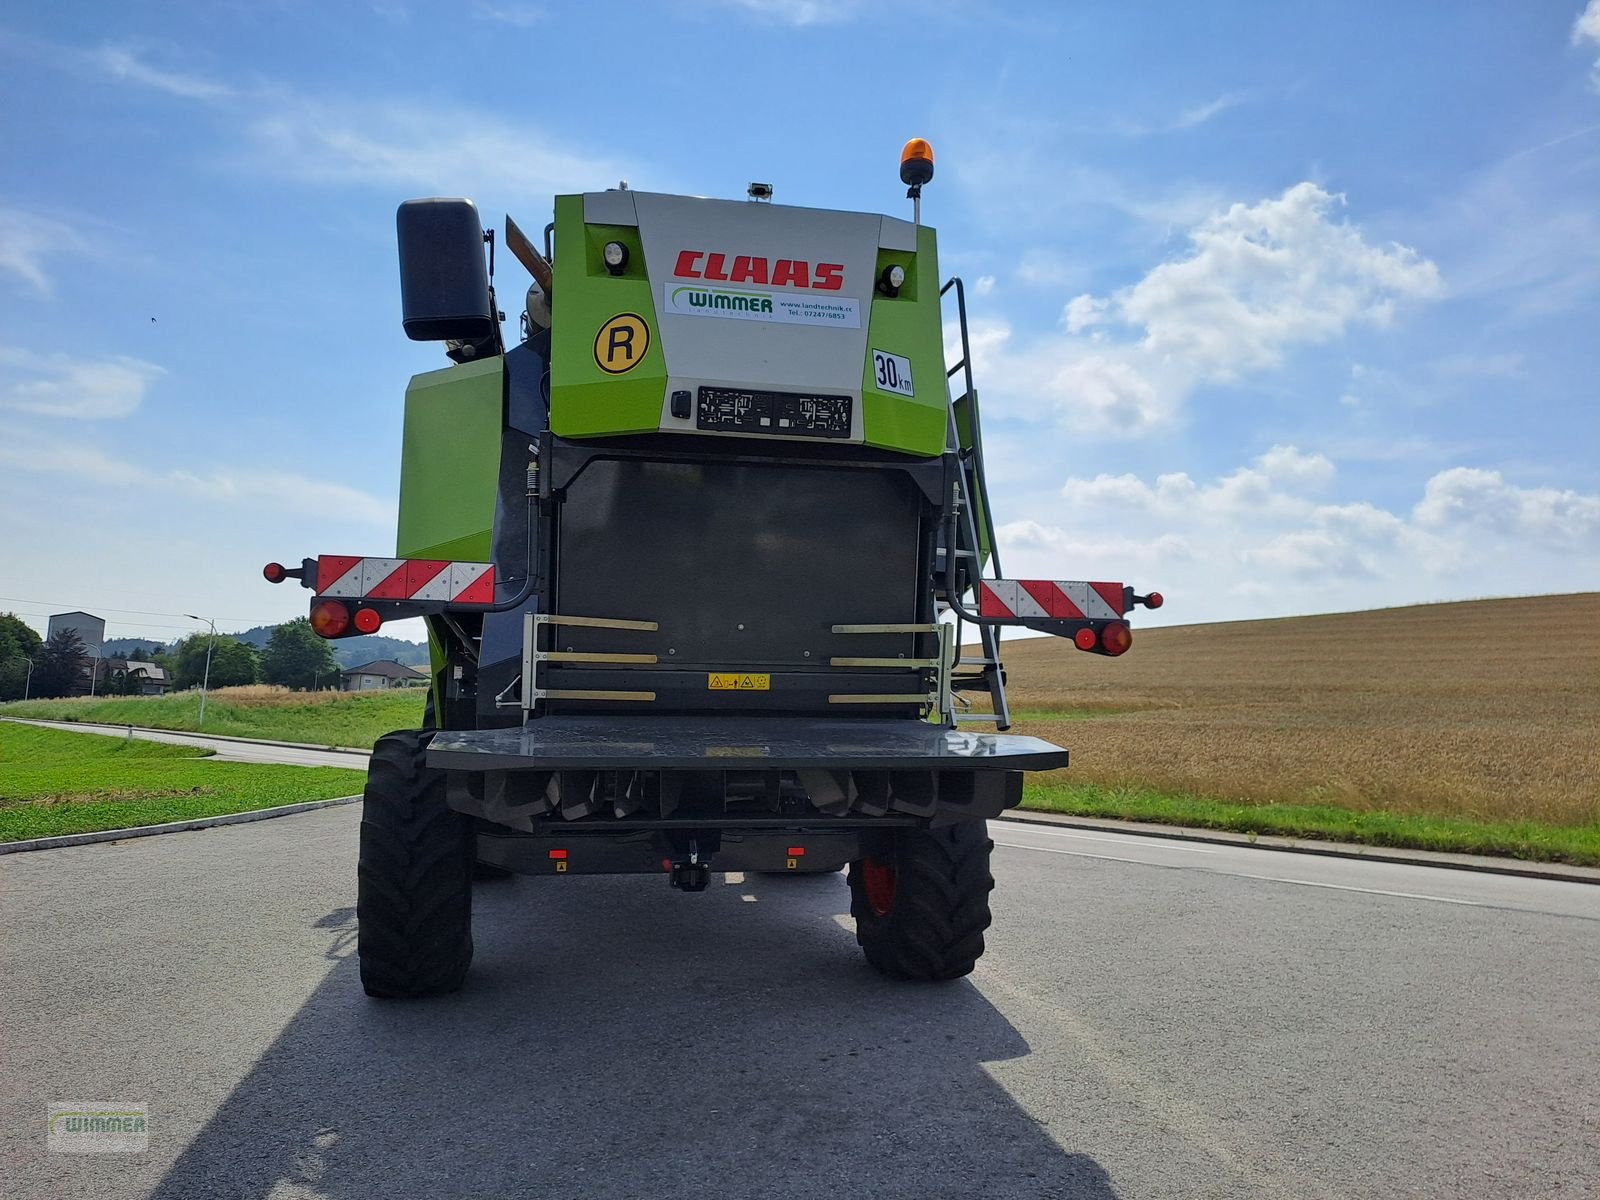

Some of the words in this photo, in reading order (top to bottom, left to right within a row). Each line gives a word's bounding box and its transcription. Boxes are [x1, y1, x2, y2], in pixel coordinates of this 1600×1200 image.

[673, 250, 845, 291] CLAAS
[689, 292, 773, 313] WIMMER
[788, 309, 803, 317] Tel.:
[804, 310, 846, 320] 07247/6853
[607, 325, 635, 363] R
[875, 354, 898, 388] 30
[898, 373, 912, 392] km
